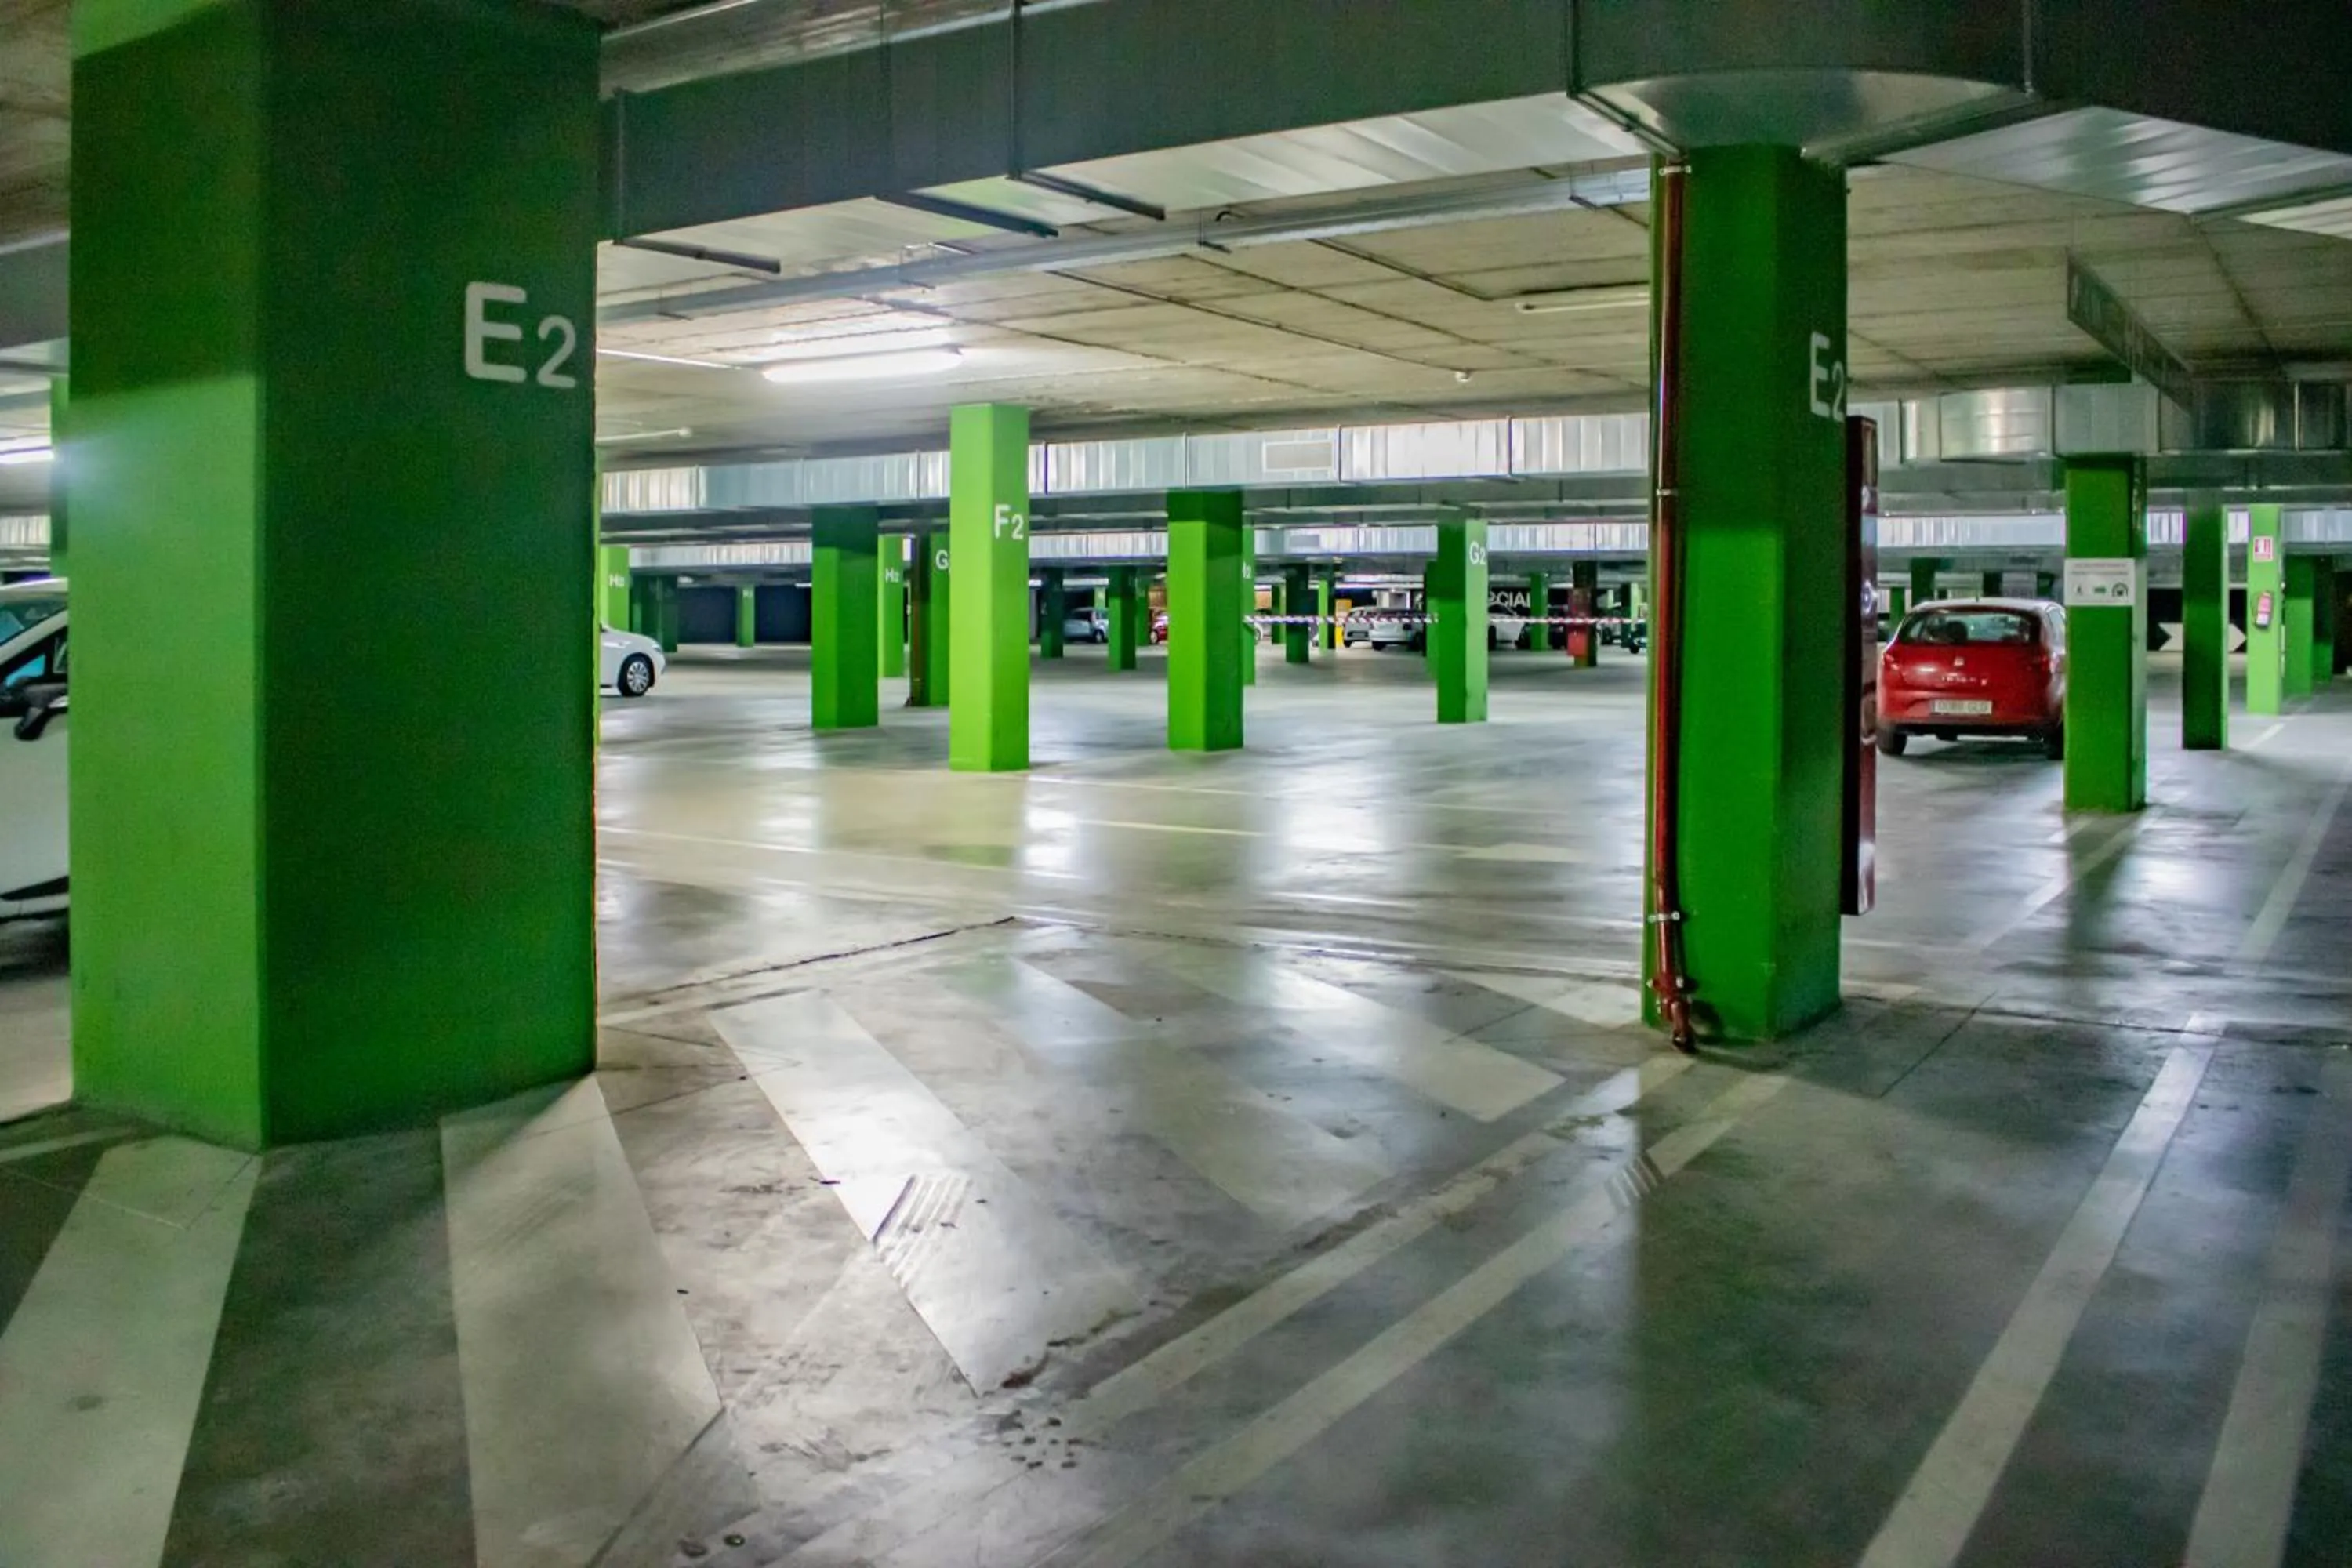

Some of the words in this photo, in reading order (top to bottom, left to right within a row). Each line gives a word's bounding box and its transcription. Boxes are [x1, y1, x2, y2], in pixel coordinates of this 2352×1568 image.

[465, 281, 576, 388] E2
[1810, 332, 1845, 423] E2
[994, 503, 1024, 540] F2
[935, 550, 949, 571] G
[1469, 540, 1486, 564] G2
